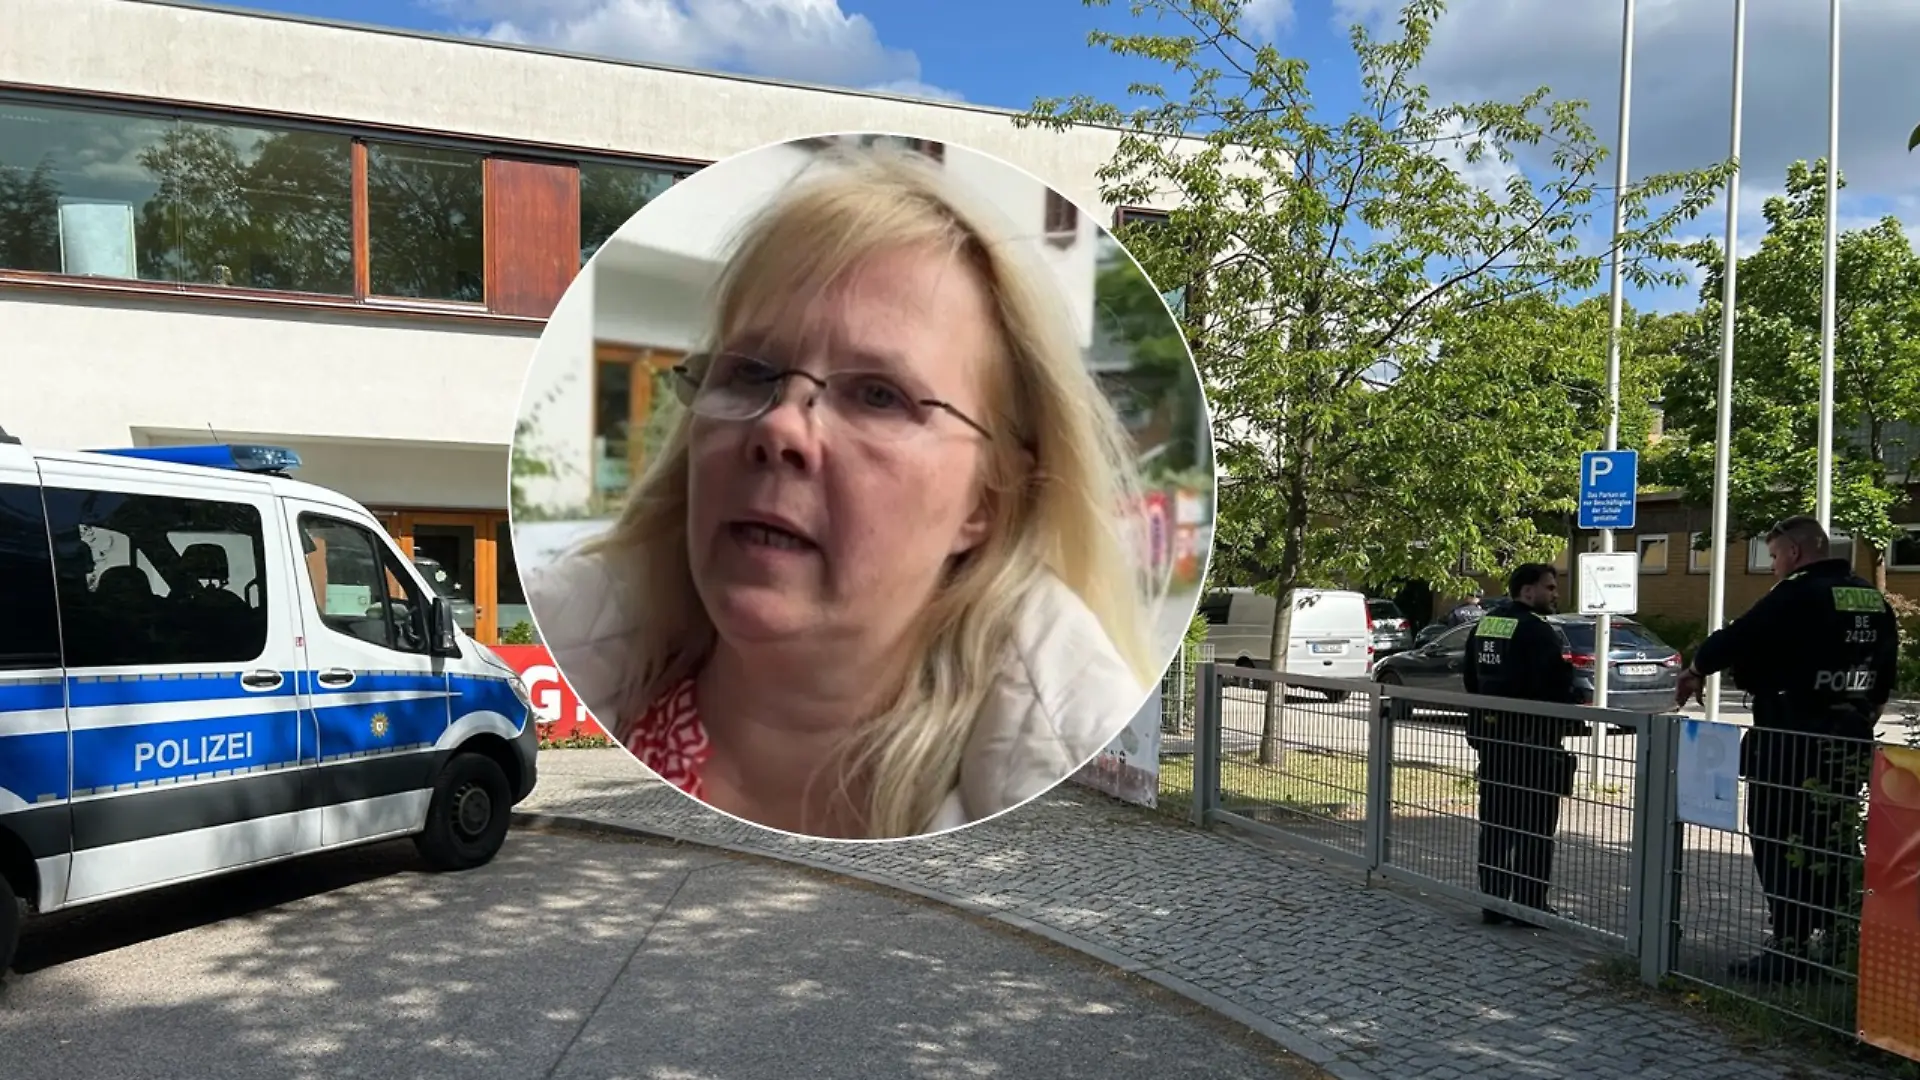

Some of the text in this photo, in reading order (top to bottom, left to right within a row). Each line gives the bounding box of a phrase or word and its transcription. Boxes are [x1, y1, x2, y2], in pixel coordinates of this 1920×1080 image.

[1589, 456, 1613, 486] P
[1855, 615, 1871, 628] BE
[1845, 630, 1877, 642] 24123
[1483, 641, 1496, 652] BE
[1478, 652, 1501, 664] 24124
[135, 731, 252, 772] POLIZEI
